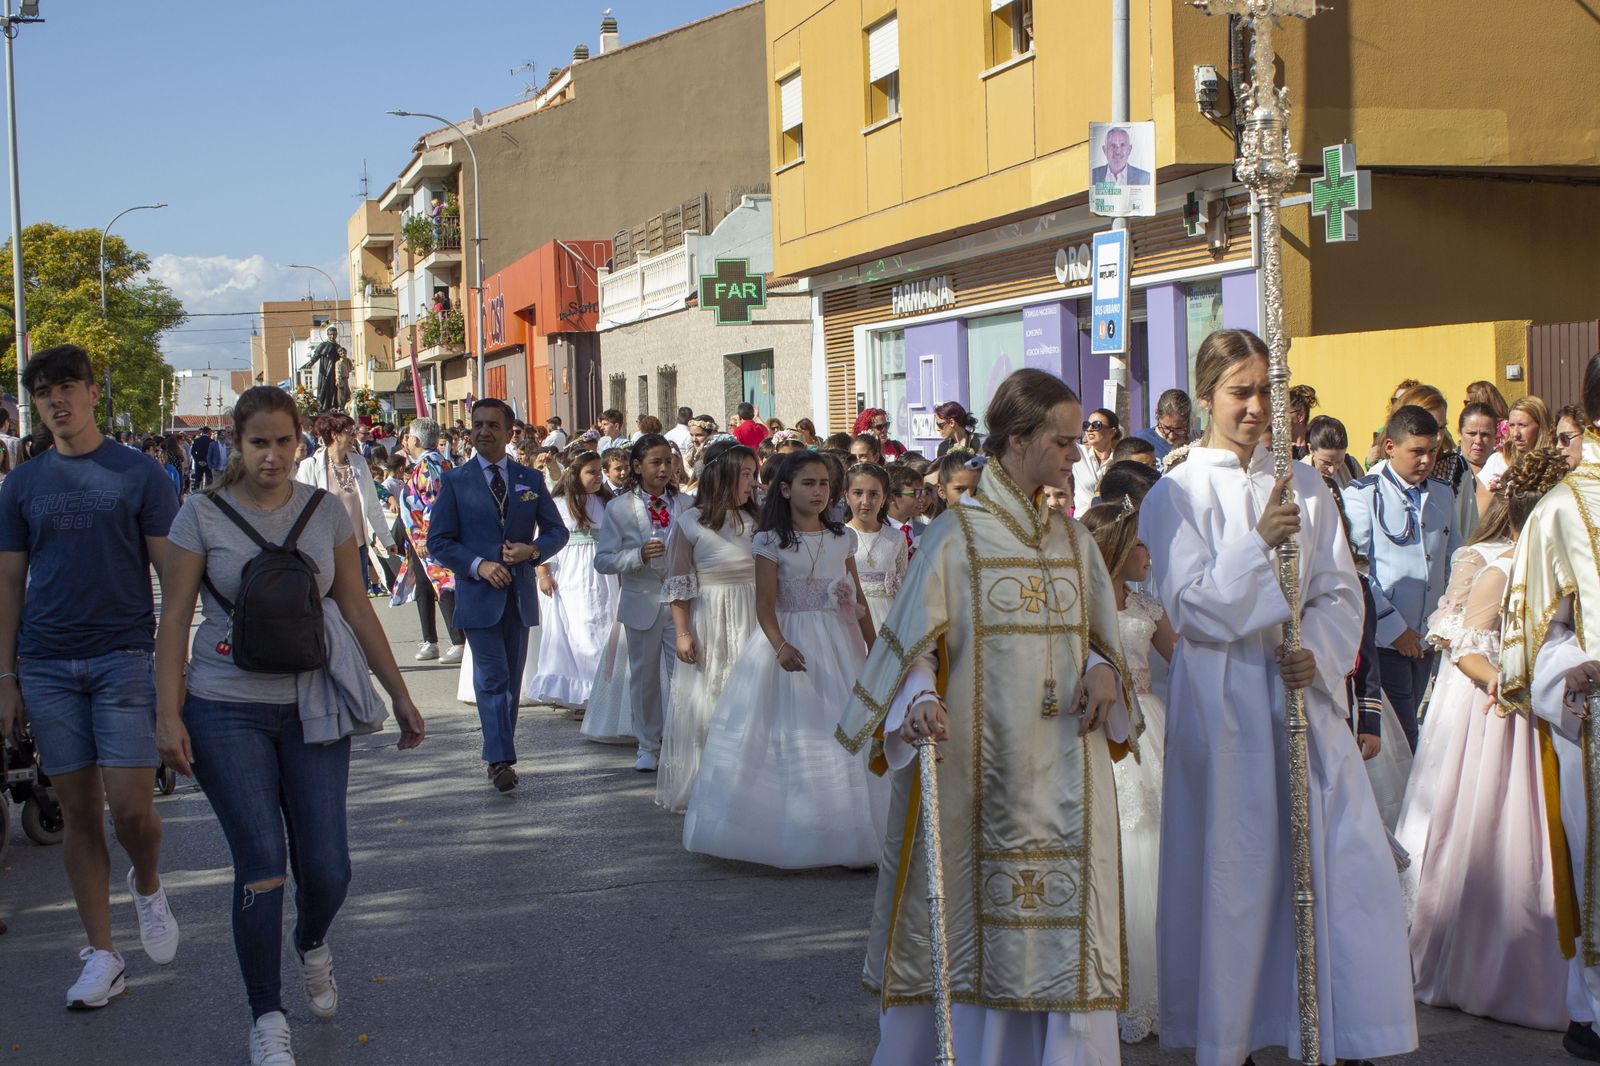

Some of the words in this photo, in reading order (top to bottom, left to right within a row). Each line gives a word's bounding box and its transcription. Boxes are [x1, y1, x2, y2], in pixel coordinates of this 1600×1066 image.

[1055, 243, 1093, 283] ORO
[715, 282, 758, 299] FAR
[892, 275, 952, 315] FARMACIA
[1094, 305, 1103, 316] BUS
[1103, 303, 1120, 315] URBANO
[31, 489, 121, 518] GUESS
[52, 513, 94, 530] 1981
